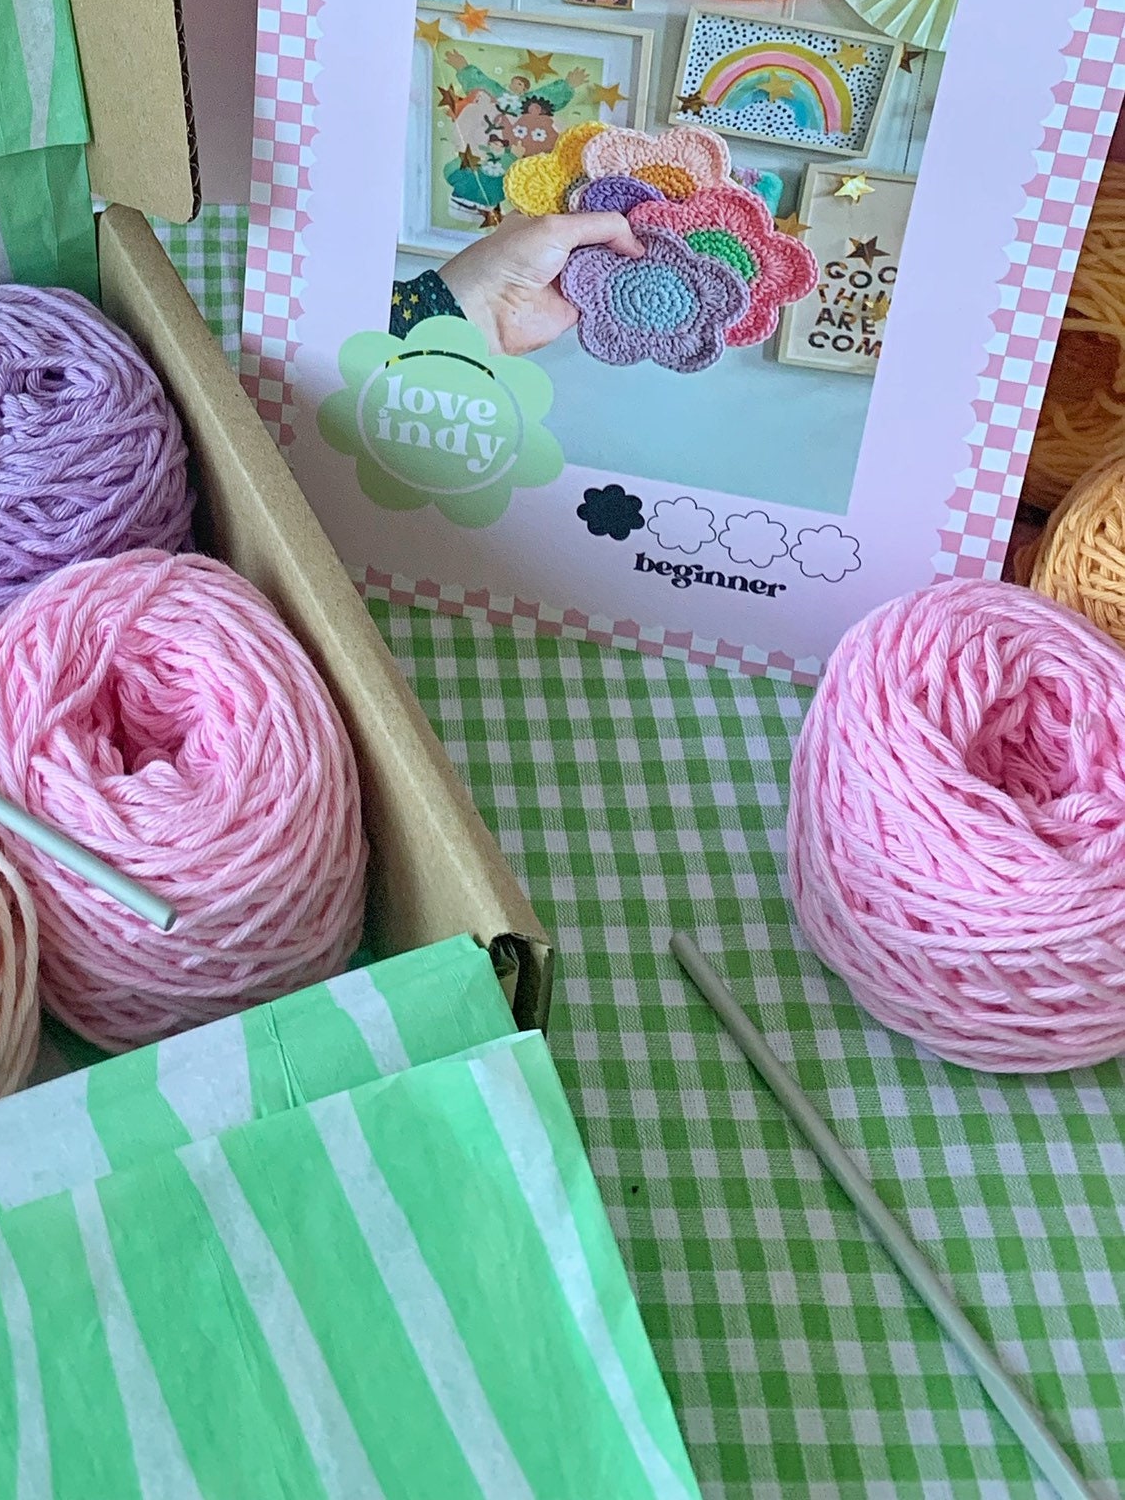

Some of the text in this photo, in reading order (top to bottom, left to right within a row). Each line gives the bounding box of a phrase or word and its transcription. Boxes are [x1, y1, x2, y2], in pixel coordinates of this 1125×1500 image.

[815, 307, 877, 336] ARE
[383, 373, 498, 427] love
[375, 407, 507, 474] indy
[632, 551, 788, 599] beginner
